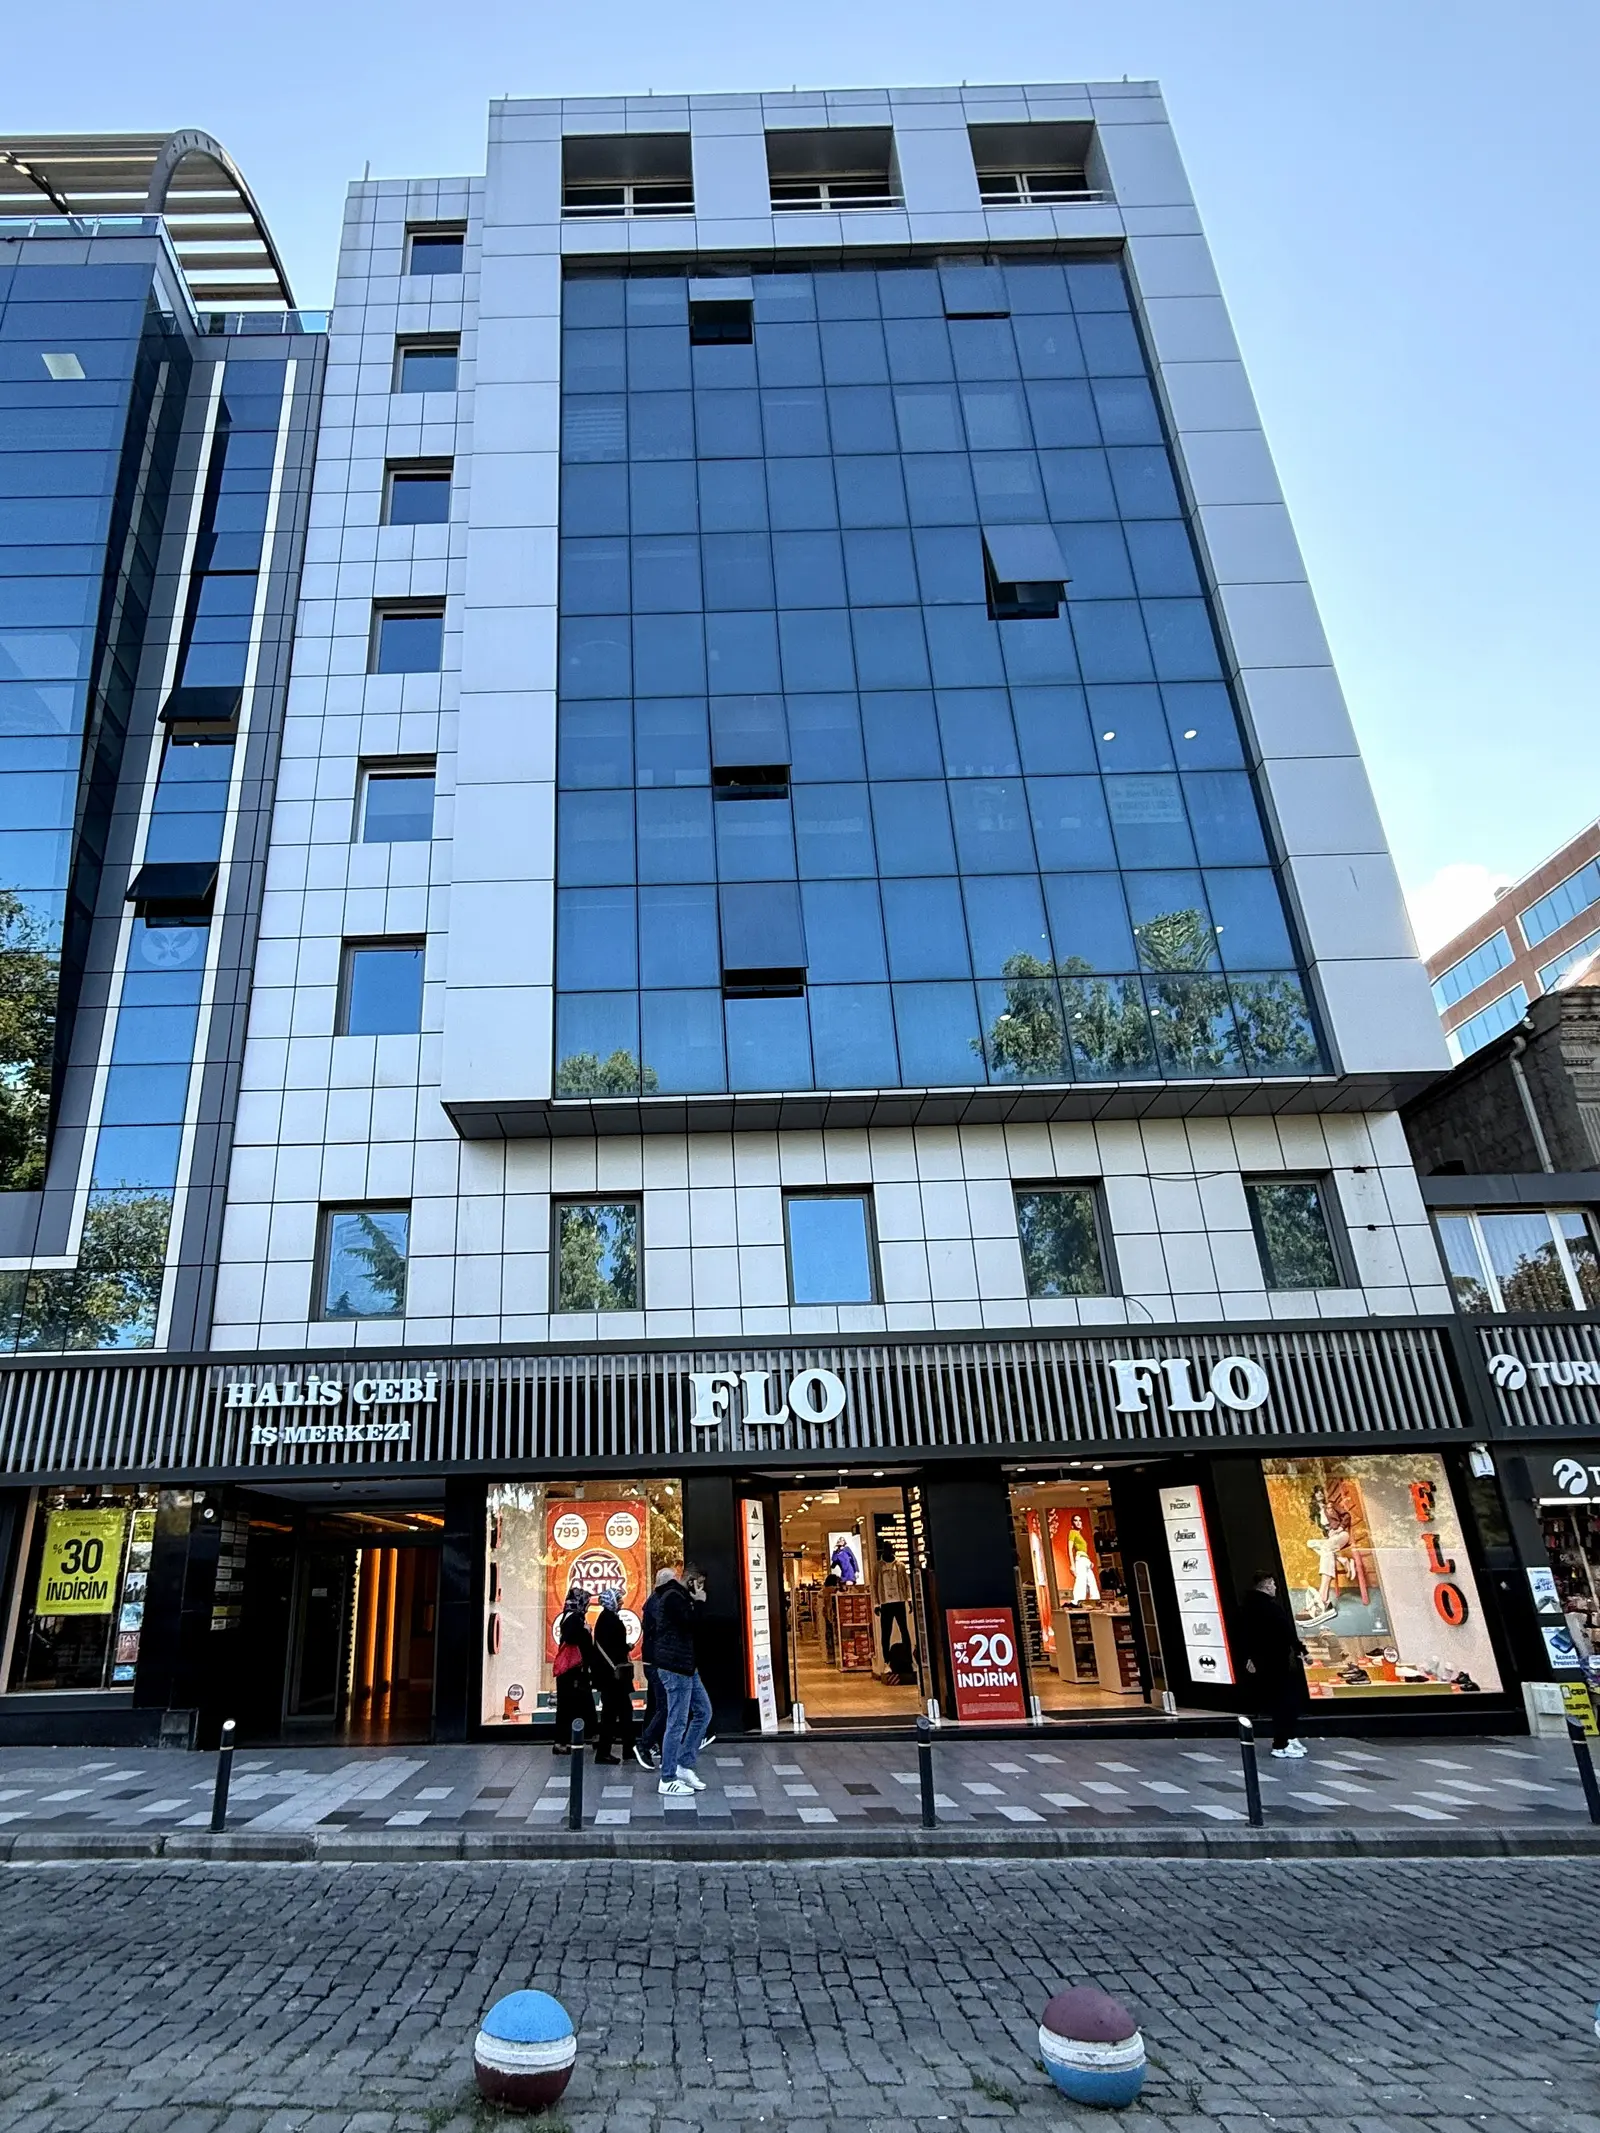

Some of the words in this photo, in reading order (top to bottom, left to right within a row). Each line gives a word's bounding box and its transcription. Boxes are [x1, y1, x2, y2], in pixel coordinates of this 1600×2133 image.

[224, 1375, 343, 1407] HALİS
[353, 1371, 439, 1411] ÇEBİ
[1108, 1356, 1270, 1412] FLO
[688, 1368, 847, 1426] FLO
[283, 1420, 411, 1444] MERKEZİ
[556, 1527, 580, 1538] 799
[608, 1525, 633, 1536] 699
[576, 1561, 618, 1578] YOK
[46, 1576, 109, 1601] İNDİRİM
[953, 1642, 968, 1650] NET
[956, 1668, 1018, 1688] İNDİRİM
